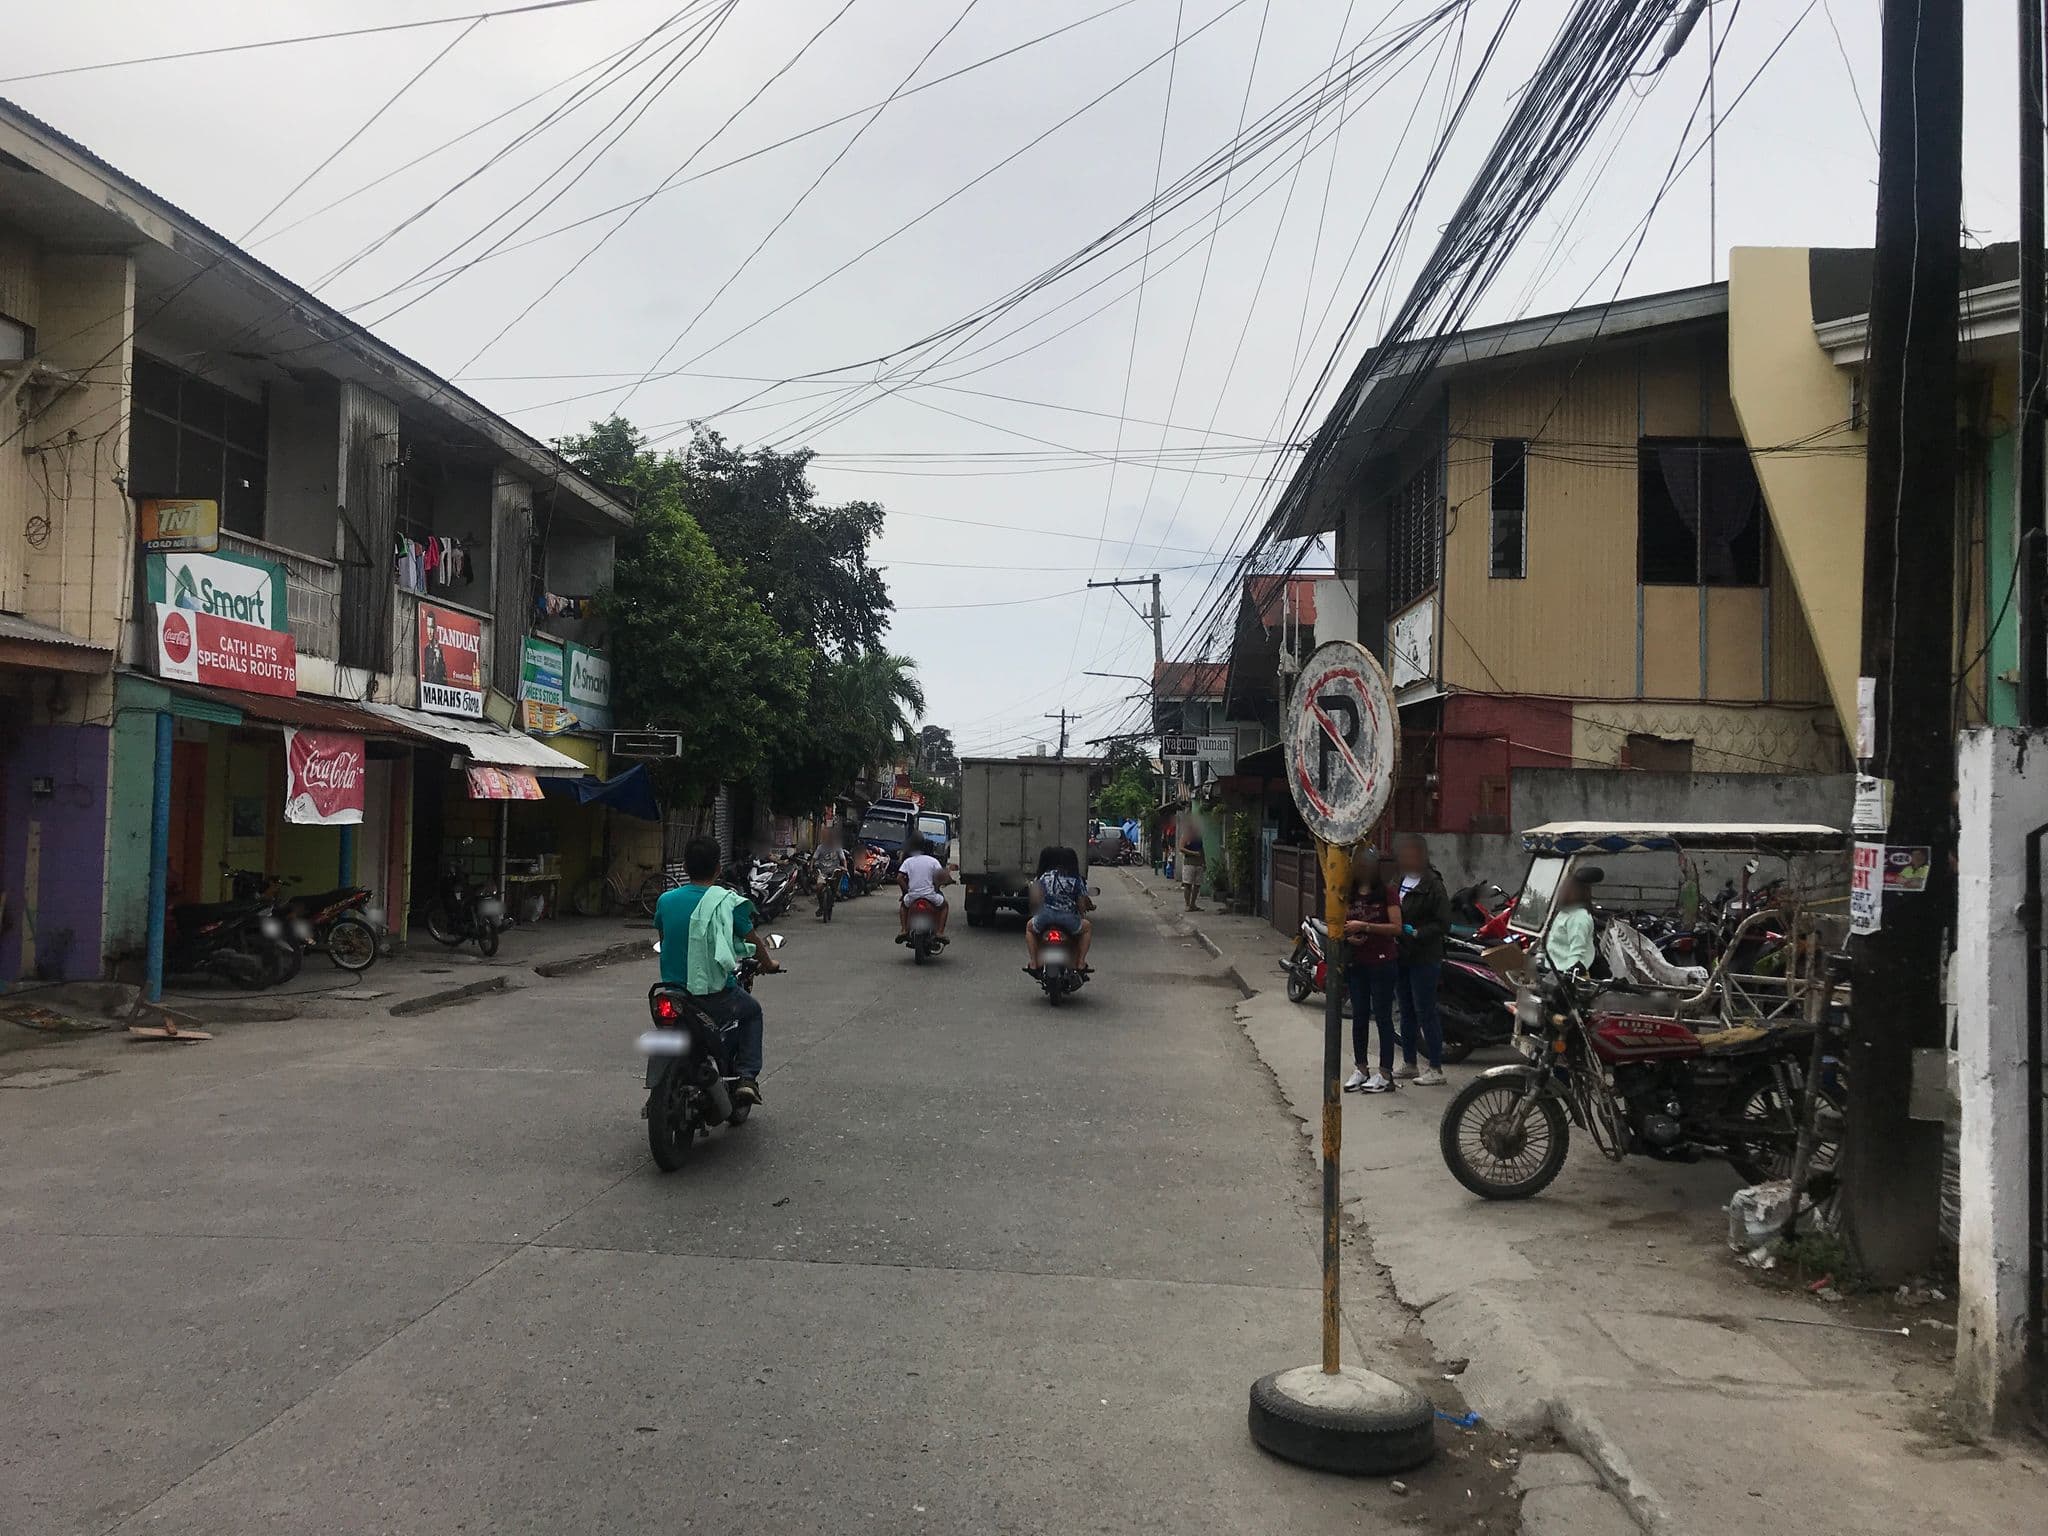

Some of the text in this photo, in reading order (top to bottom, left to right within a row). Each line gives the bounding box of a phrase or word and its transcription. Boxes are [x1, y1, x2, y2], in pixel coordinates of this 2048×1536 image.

[159, 506, 200, 532] TNT
[201, 578, 264, 624] Smart
[220, 636, 277, 661] CATH LEY'S
[437, 625, 480, 653] TANDUAY
[198, 649, 247, 674] SPECIALS
[250, 661, 282, 679] ROUTE
[284, 666, 296, 681] 78
[581, 667, 608, 696] Smart
[423, 686, 461, 708] MARAHS
[1317, 695, 1360, 791] P
